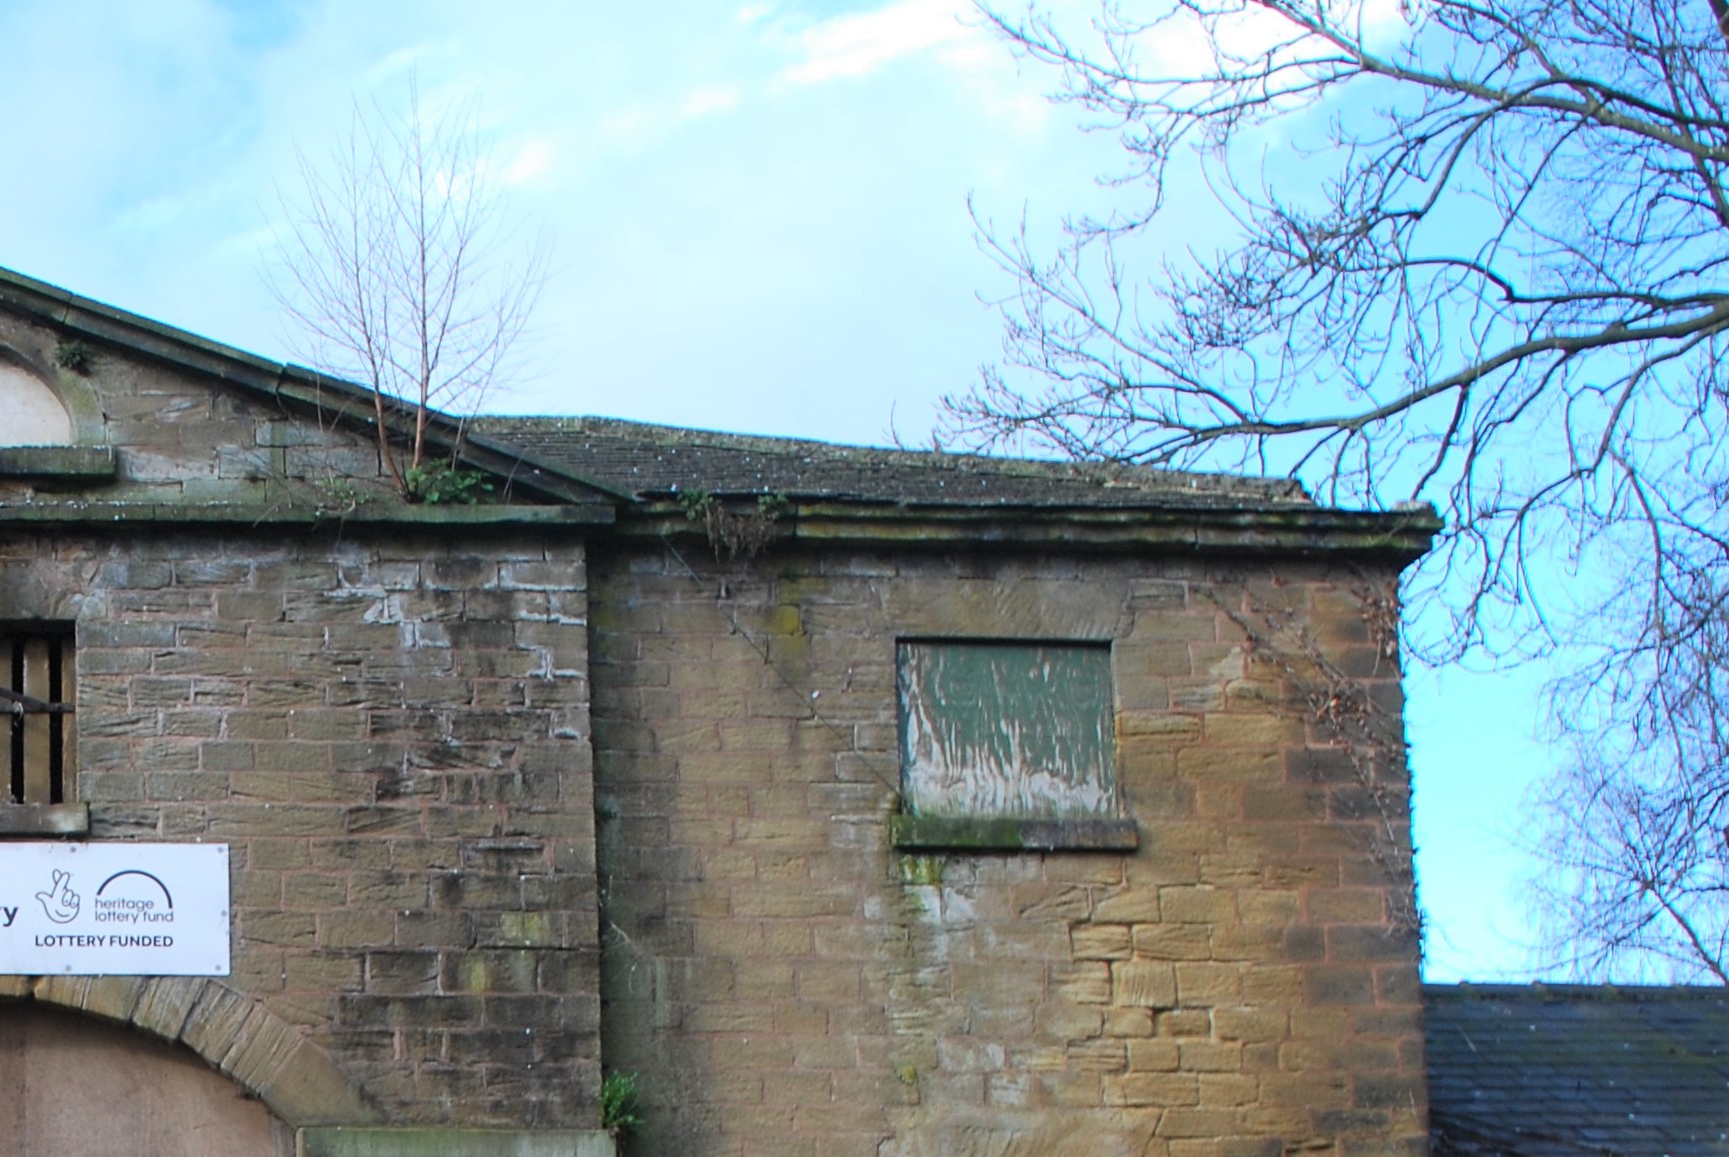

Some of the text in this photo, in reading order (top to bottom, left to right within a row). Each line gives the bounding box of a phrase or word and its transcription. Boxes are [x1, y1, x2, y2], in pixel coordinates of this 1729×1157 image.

[95, 897, 155, 913] heritage
[95, 910, 174, 924] lottery fund
[34, 934, 174, 947] LOTTERY FUNDED
